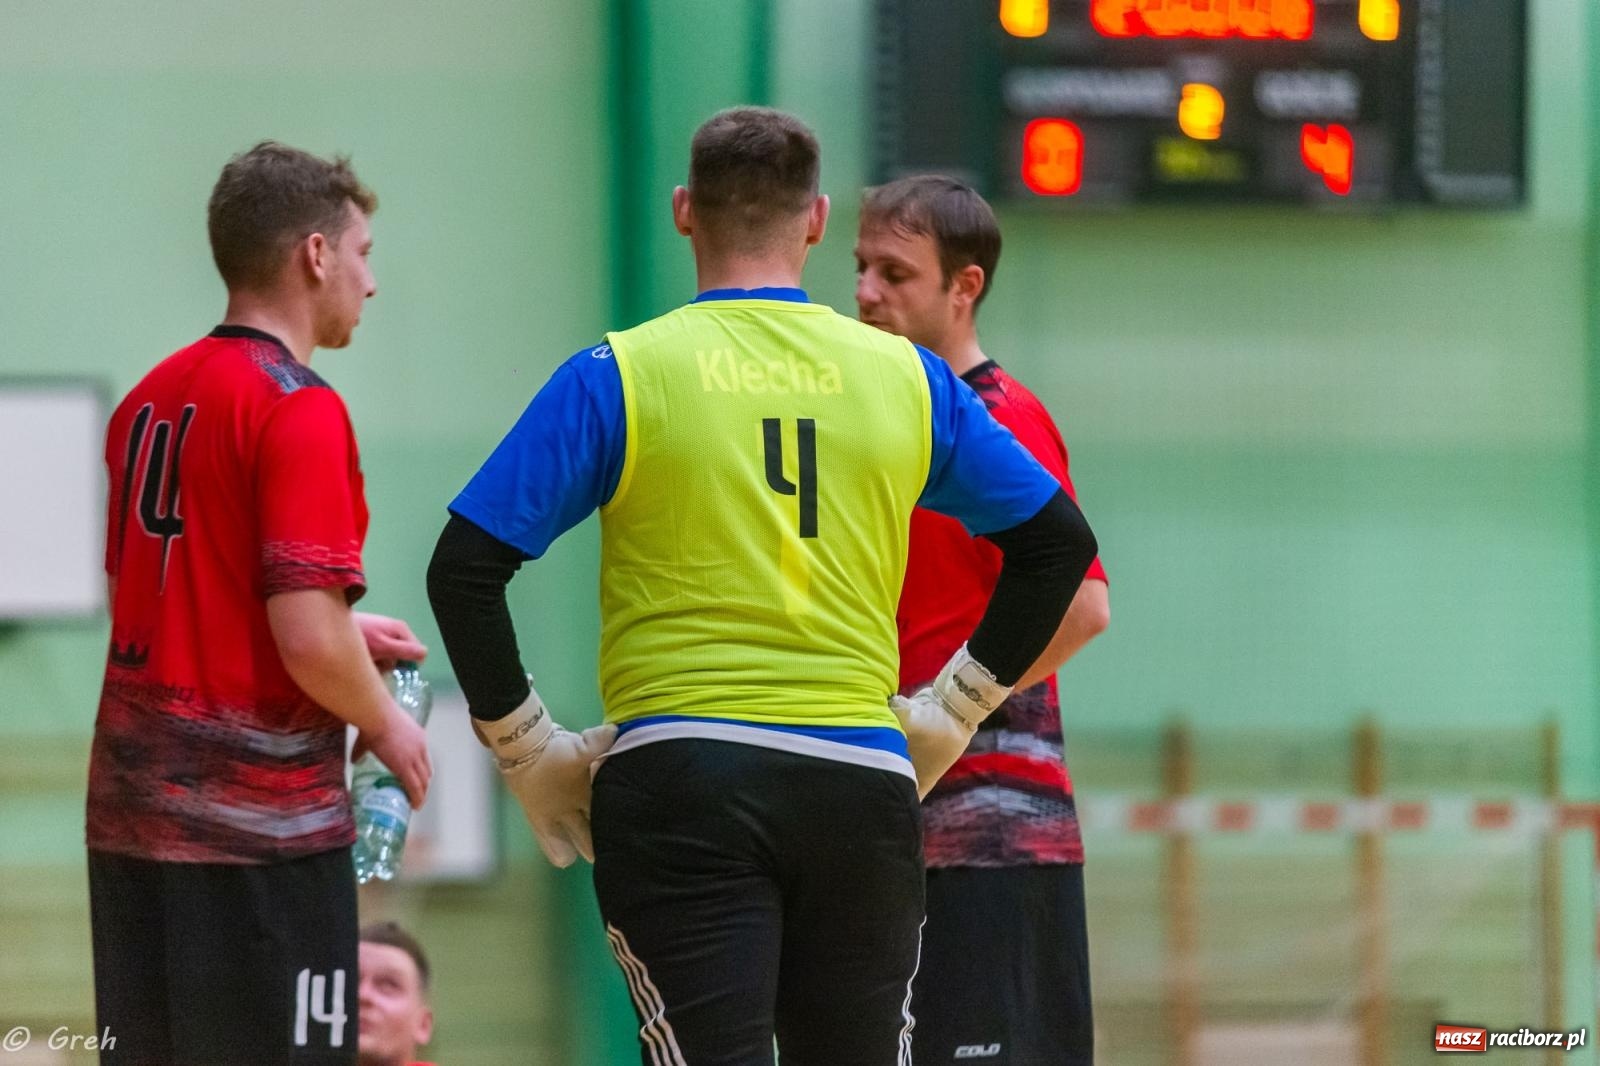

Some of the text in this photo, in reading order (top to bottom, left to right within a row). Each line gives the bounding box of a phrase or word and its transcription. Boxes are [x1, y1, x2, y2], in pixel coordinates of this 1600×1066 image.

[694, 346, 845, 396] Klecha
[115, 402, 197, 596] 14
[762, 418, 818, 538] 4
[294, 968, 348, 1047] 14
